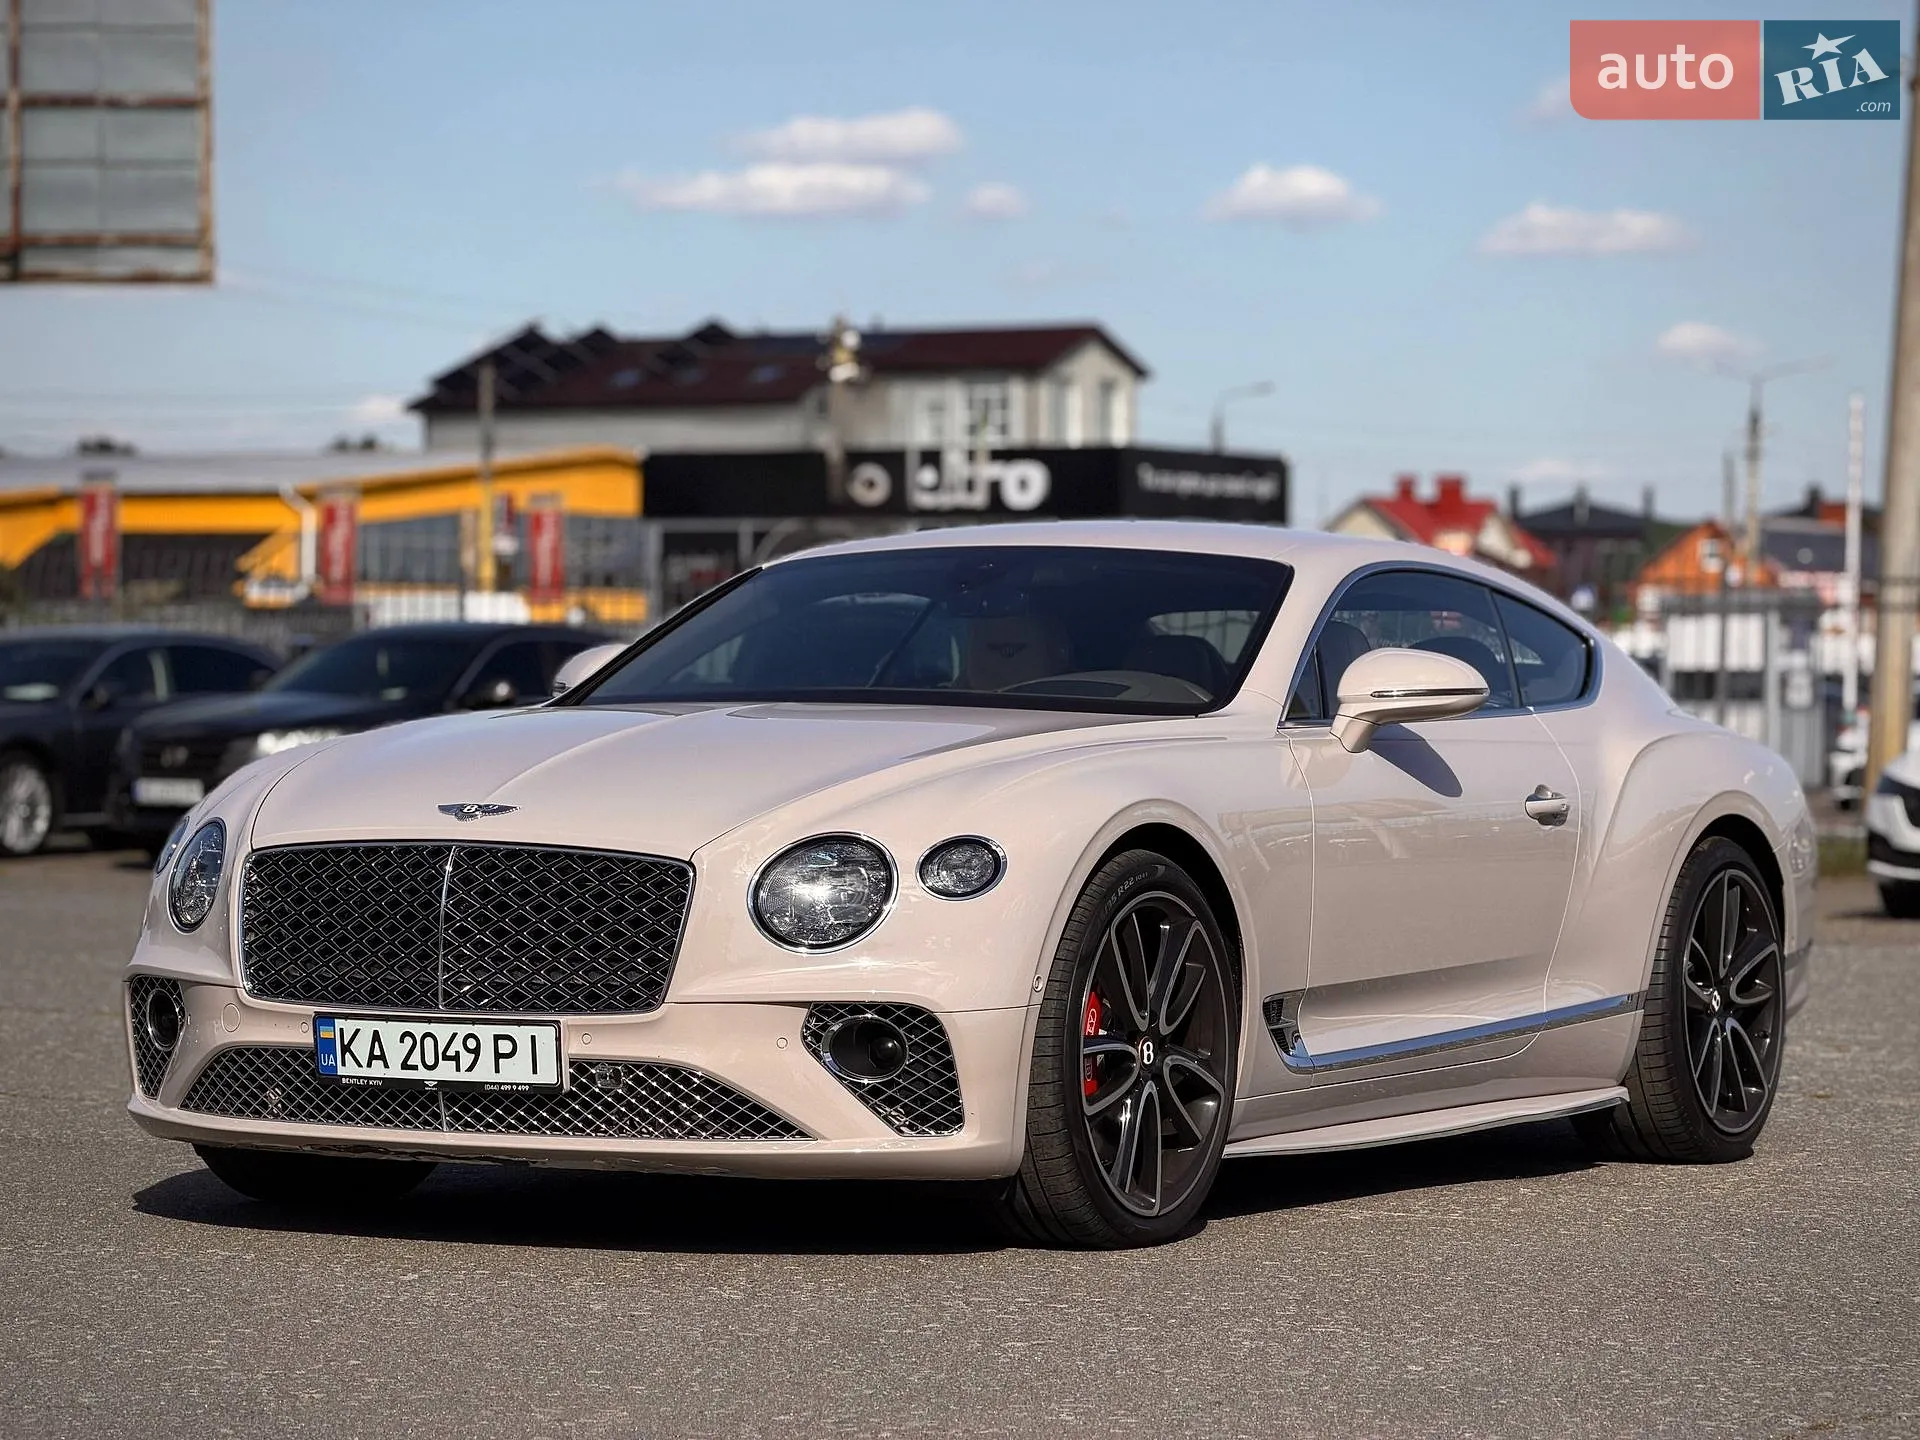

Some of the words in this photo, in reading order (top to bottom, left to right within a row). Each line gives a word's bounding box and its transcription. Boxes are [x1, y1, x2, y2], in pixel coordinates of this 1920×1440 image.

[339, 1027, 390, 1069] KA
[399, 1030, 482, 1073] 2049
[321, 1053, 336, 1067] UA
[341, 1077, 368, 1086] BENTLEY
